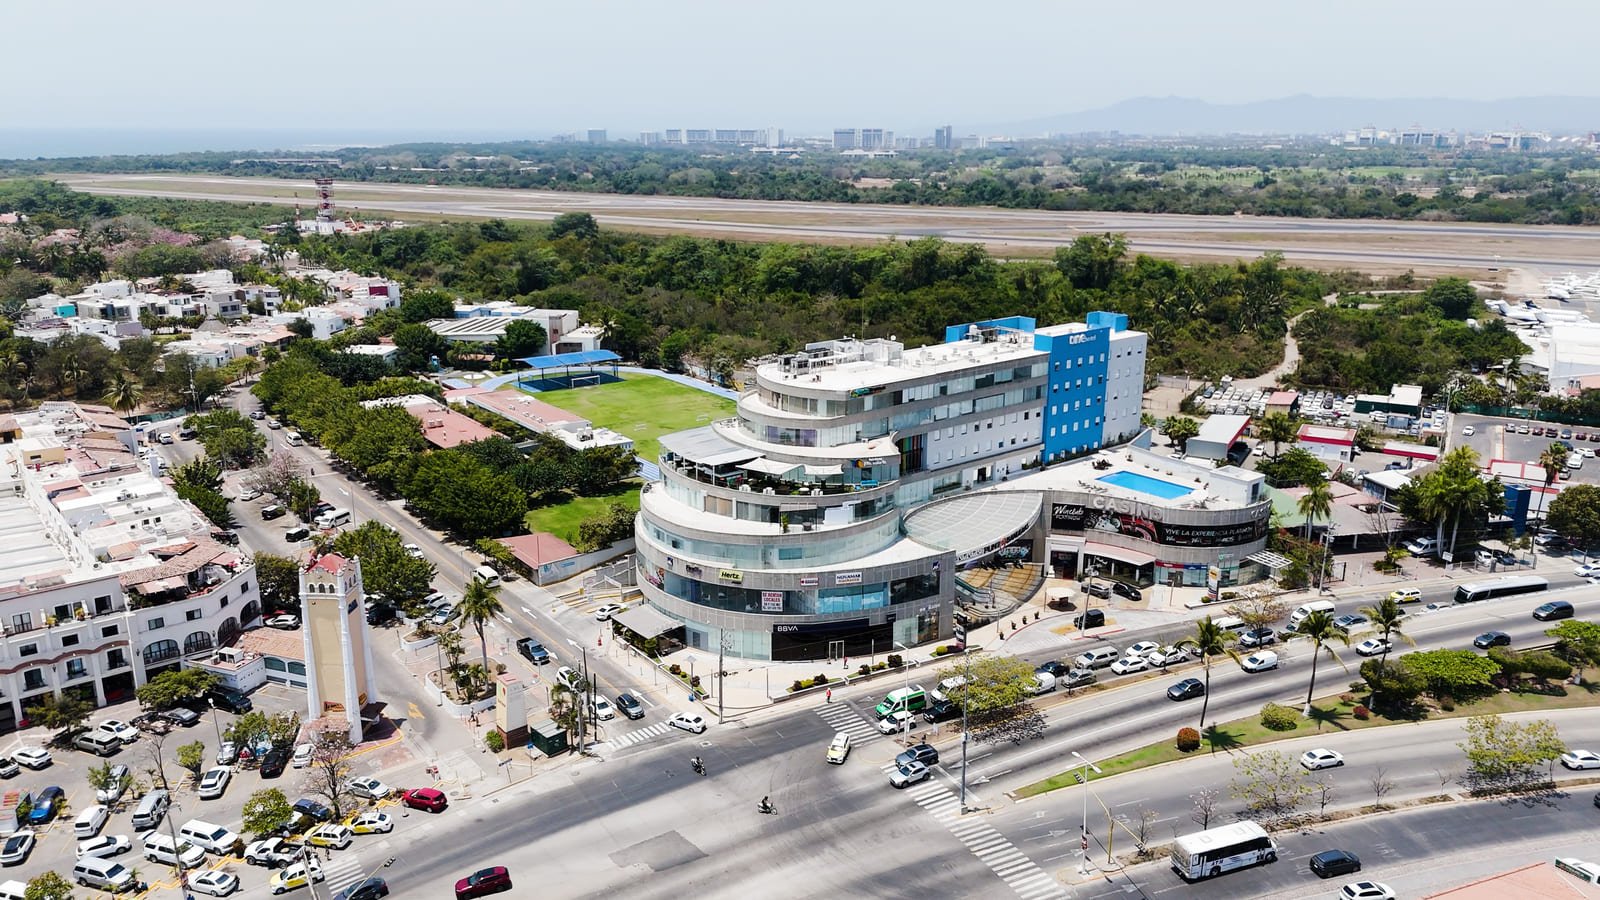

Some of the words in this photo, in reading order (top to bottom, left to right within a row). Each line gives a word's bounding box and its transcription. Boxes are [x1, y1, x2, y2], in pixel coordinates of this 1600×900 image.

[1093, 496, 1164, 521] CASINO
[1165, 528, 1179, 536] VIVE
[721, 571, 740, 580] Hertz
